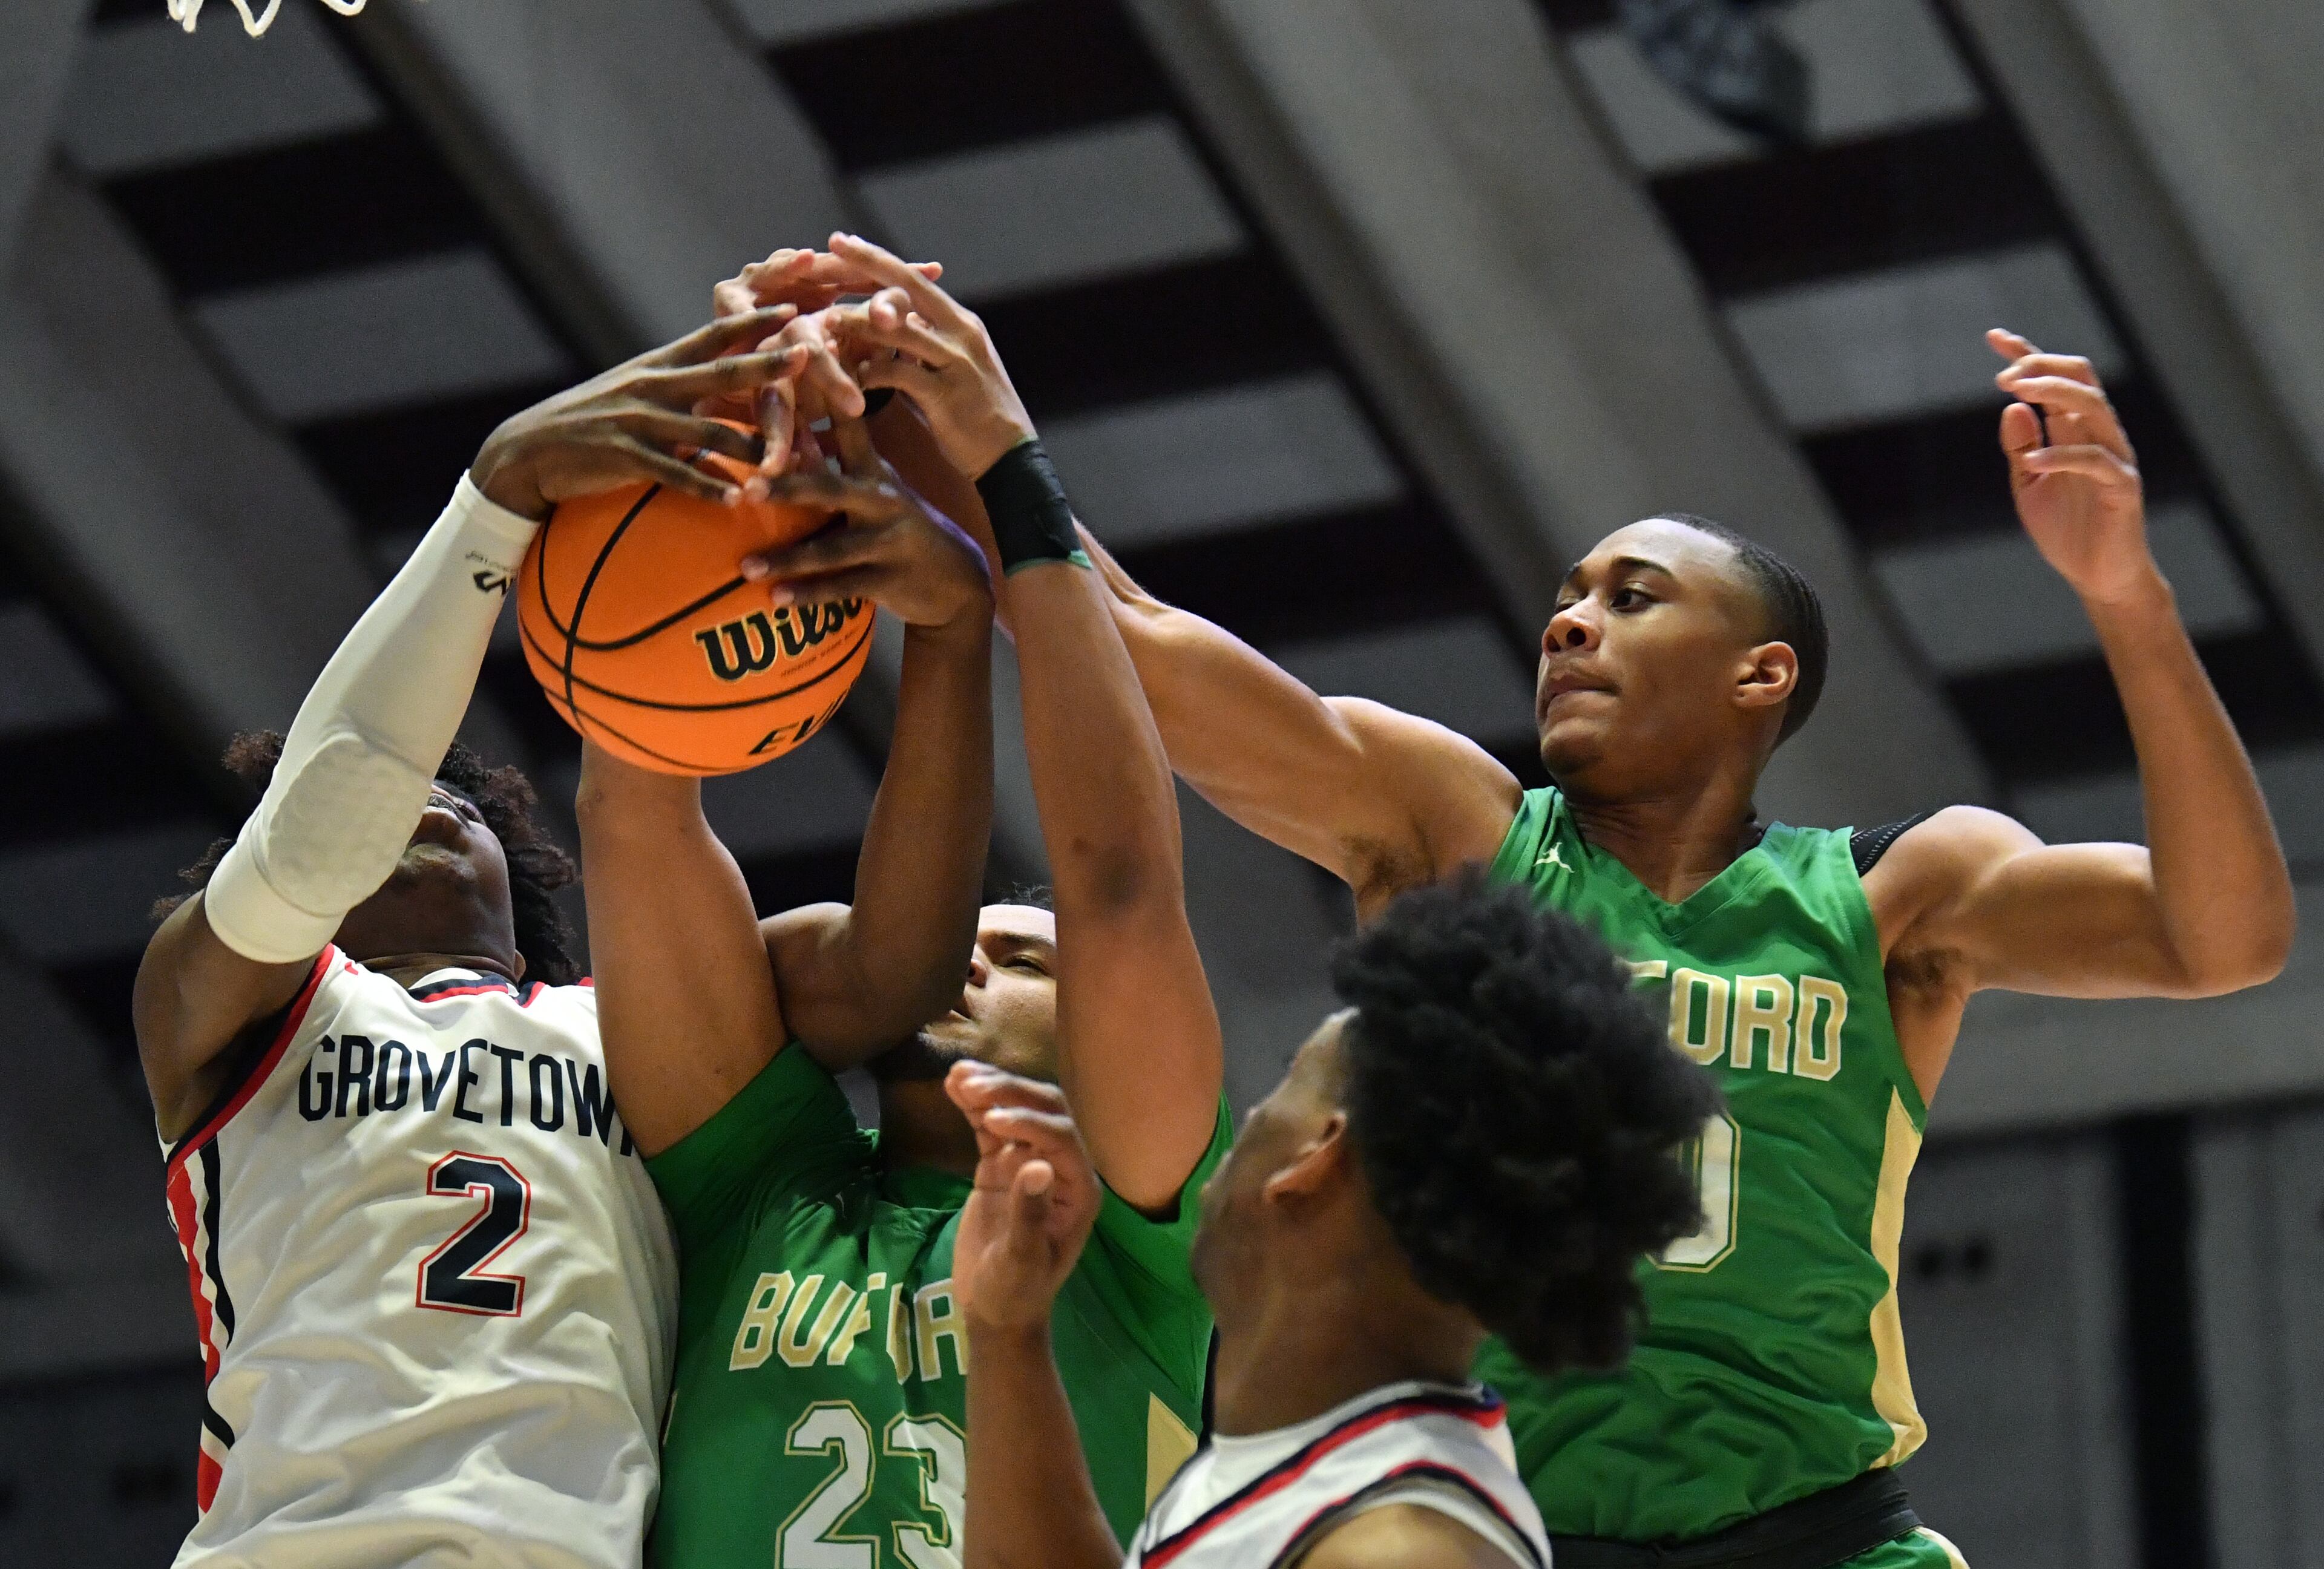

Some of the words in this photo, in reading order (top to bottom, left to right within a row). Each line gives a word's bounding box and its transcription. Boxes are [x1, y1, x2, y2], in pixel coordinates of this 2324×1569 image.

[298, 1033, 632, 1157] GROVETOW
[416, 1150, 531, 1317] 2
[775, 1399, 967, 1569] 23
